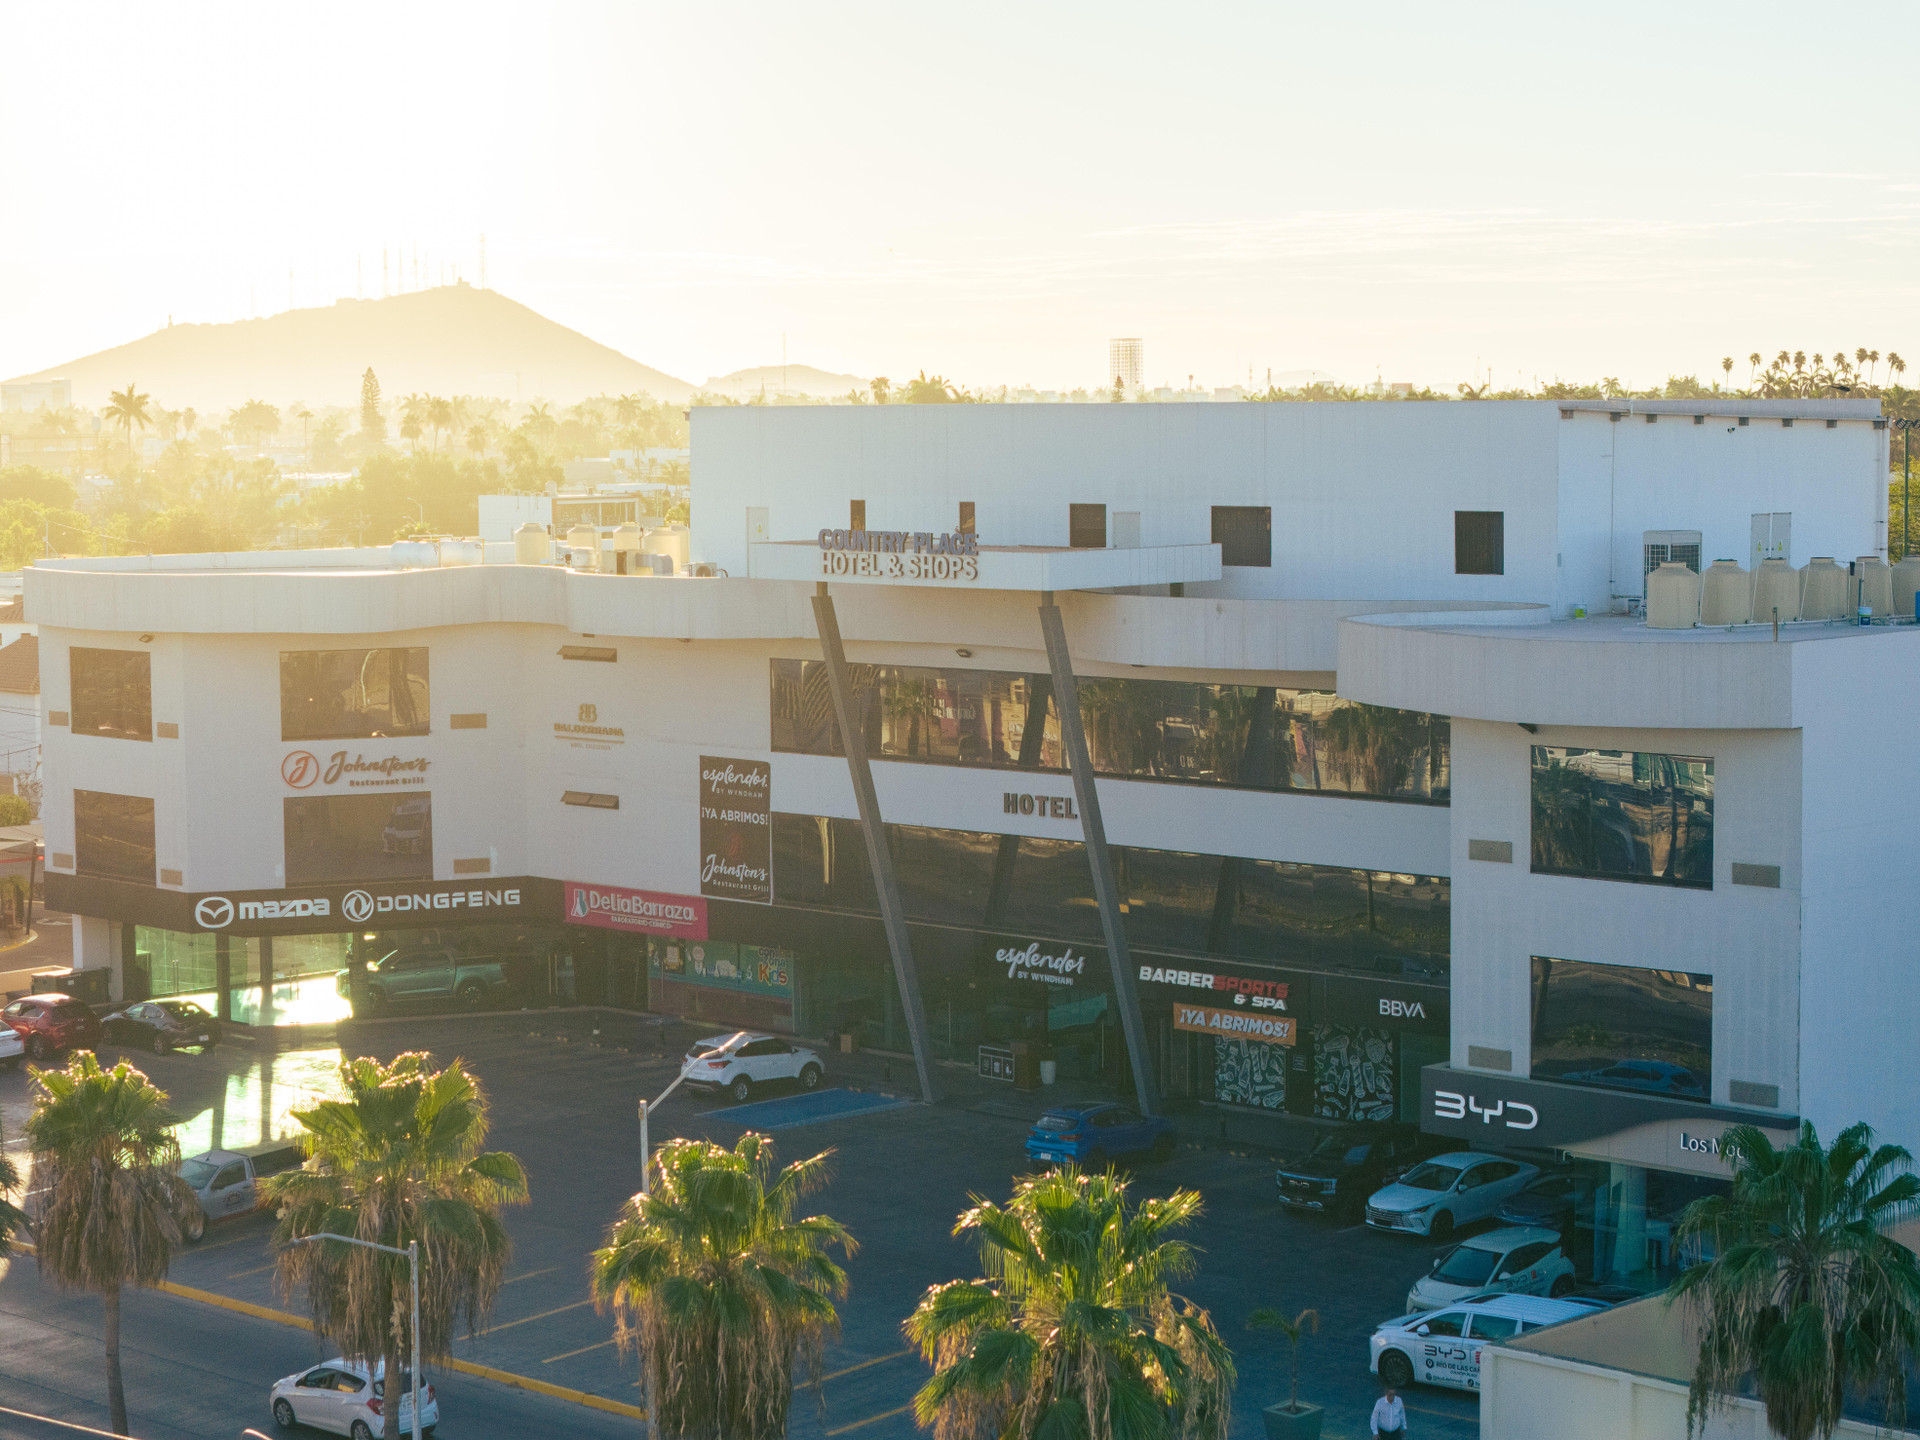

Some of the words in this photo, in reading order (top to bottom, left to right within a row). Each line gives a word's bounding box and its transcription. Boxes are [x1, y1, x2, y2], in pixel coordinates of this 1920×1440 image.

[818, 528, 909, 553] COUNTRY
[913, 532, 979, 556] PLACE
[822, 552, 883, 576] HOTEL
[888, 554, 904, 578] &
[908, 555, 979, 581] SHOPS
[323, 750, 431, 785] Johnston's
[727, 789, 763, 798] WYNDHAM
[720, 809, 769, 825] ABRIMOS!
[1003, 792, 1078, 820] HOTEL
[701, 853, 769, 883] Johnston's
[713, 879, 751, 890] Restaurant
[376, 889, 521, 913] DONGFENG
[995, 942, 1086, 979] esplendor
[758, 963, 789, 986] Kids
[1017, 971, 1028, 979] BY
[1031, 972, 1074, 986] WYNDHAM
[1234, 993, 1246, 1005] &
[1251, 996, 1287, 1011] SPA
[1379, 998, 1426, 1019] BBVA
[1180, 1009, 1207, 1027] ¡YA
[1209, 1013, 1290, 1039] ABRIMOS!
[1434, 1090, 1539, 1130] BYD
[1680, 1132, 1708, 1153] Los
[1424, 1345, 1466, 1360] BYD
